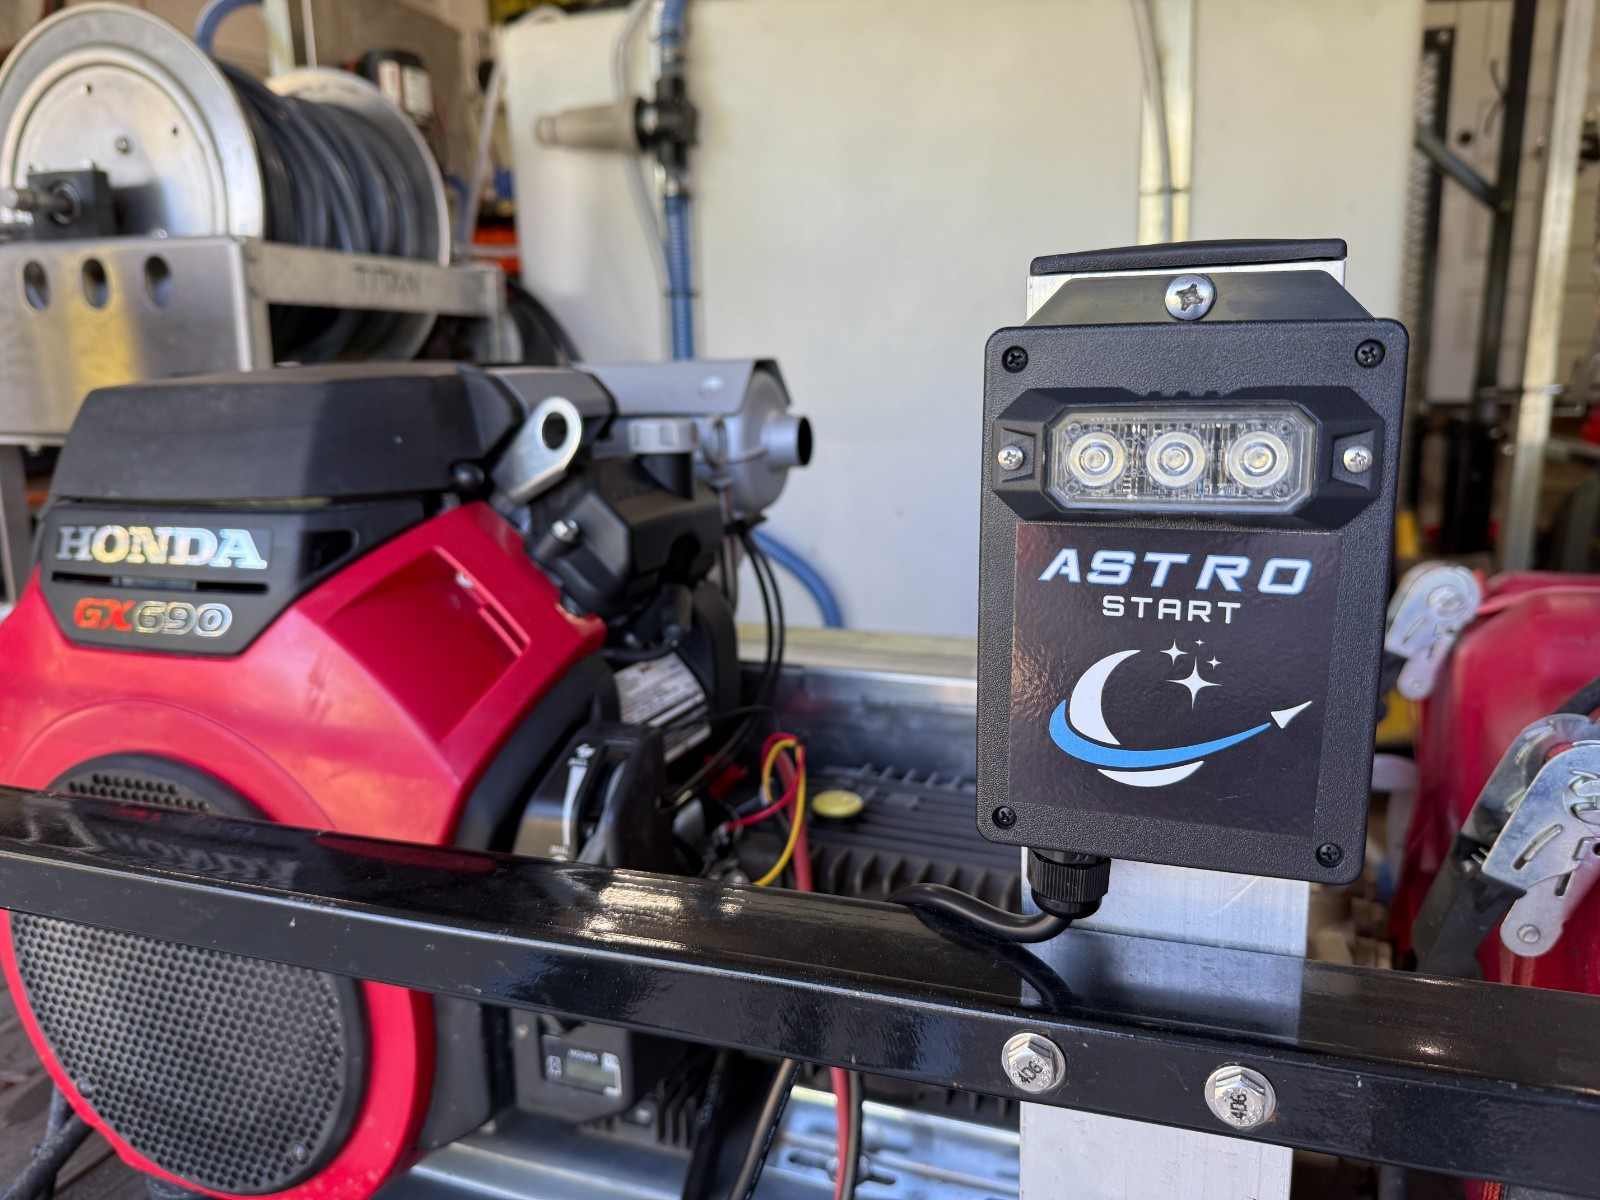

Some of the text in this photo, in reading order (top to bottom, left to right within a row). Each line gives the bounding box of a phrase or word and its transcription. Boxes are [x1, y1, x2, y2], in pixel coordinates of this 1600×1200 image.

[55, 525, 268, 569] HONDA
[1037, 547, 1312, 595] ASTRO
[73, 597, 233, 637] GX690
[1102, 595, 1241, 625] START
